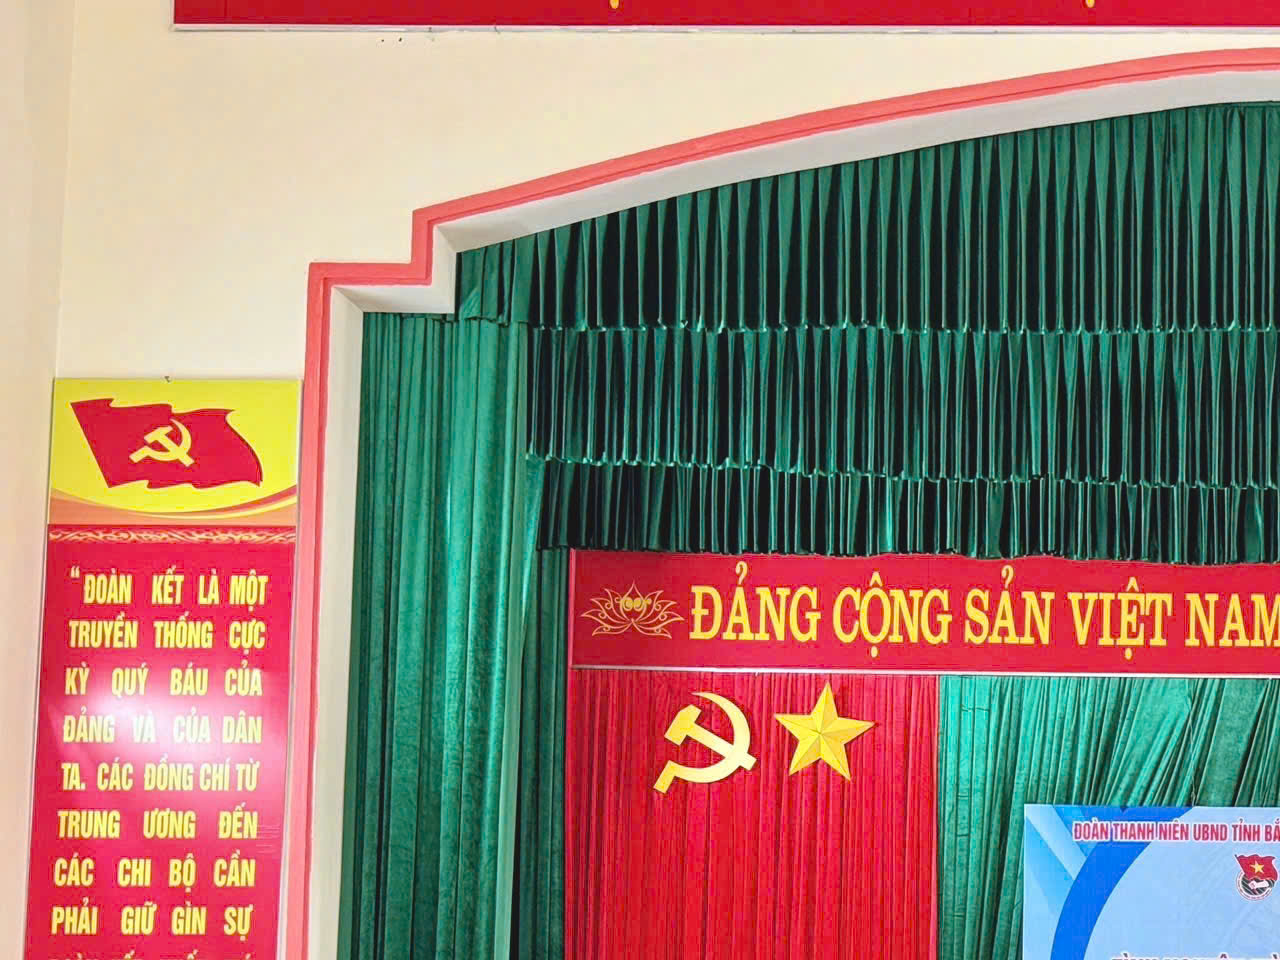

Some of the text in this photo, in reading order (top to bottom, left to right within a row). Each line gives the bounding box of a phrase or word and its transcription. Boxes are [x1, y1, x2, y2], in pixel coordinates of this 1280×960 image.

[152, 565, 184, 605] KẾT
[199, 569, 220, 605] LÀ
[230, 569, 268, 612] MỘT
[690, 560, 821, 641] ĐẢNG
[833, 572, 952, 658] CỘNG
[965, 566, 1054, 646] SẢN
[1068, 578, 1172, 661] VIỆT
[69, 611, 265, 655] TRUYỀN THỐNG CỰC
[58, 802, 258, 839] TRUNG ƯƠNG ĐẾN
[1074, 818, 1109, 840] ĐOÀN
[1113, 823, 1154, 841] THANH
[1158, 821, 1189, 841] NIÊN
[1193, 824, 1228, 841] UBND
[1232, 818, 1260, 842] TỈNH
[55, 850, 256, 893] CÁC CHI BỘ CẦN
